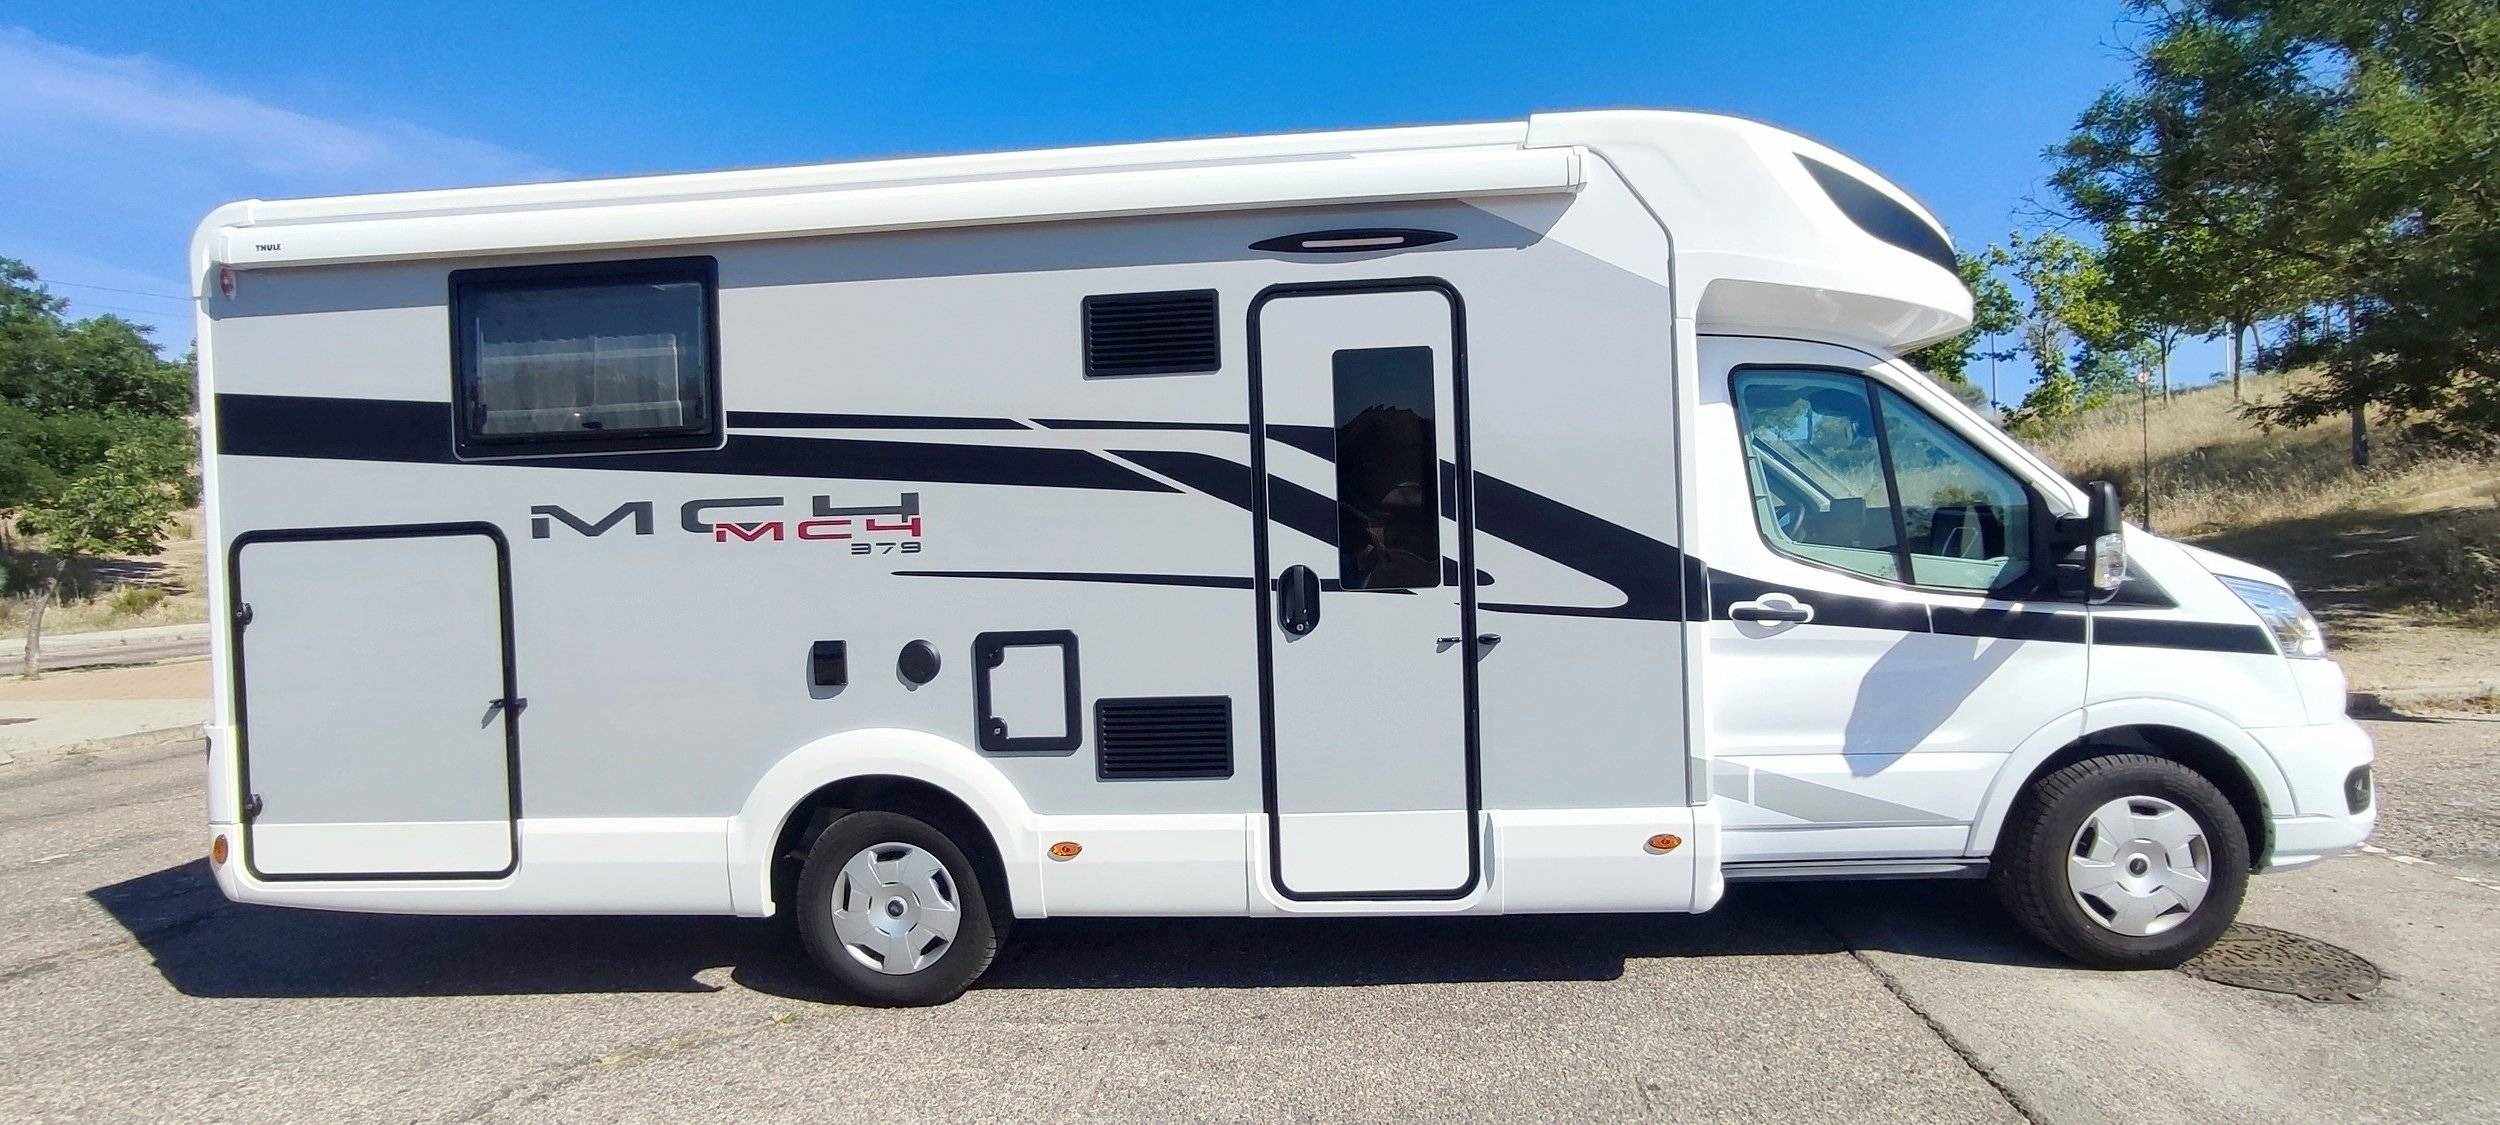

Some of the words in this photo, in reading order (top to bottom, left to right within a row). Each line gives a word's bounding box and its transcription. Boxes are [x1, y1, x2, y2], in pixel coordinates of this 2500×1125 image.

[255, 243, 282, 252] THULE
[530, 492, 920, 539] MC4
[715, 517, 921, 542] MC4
[850, 541, 922, 555] 379
